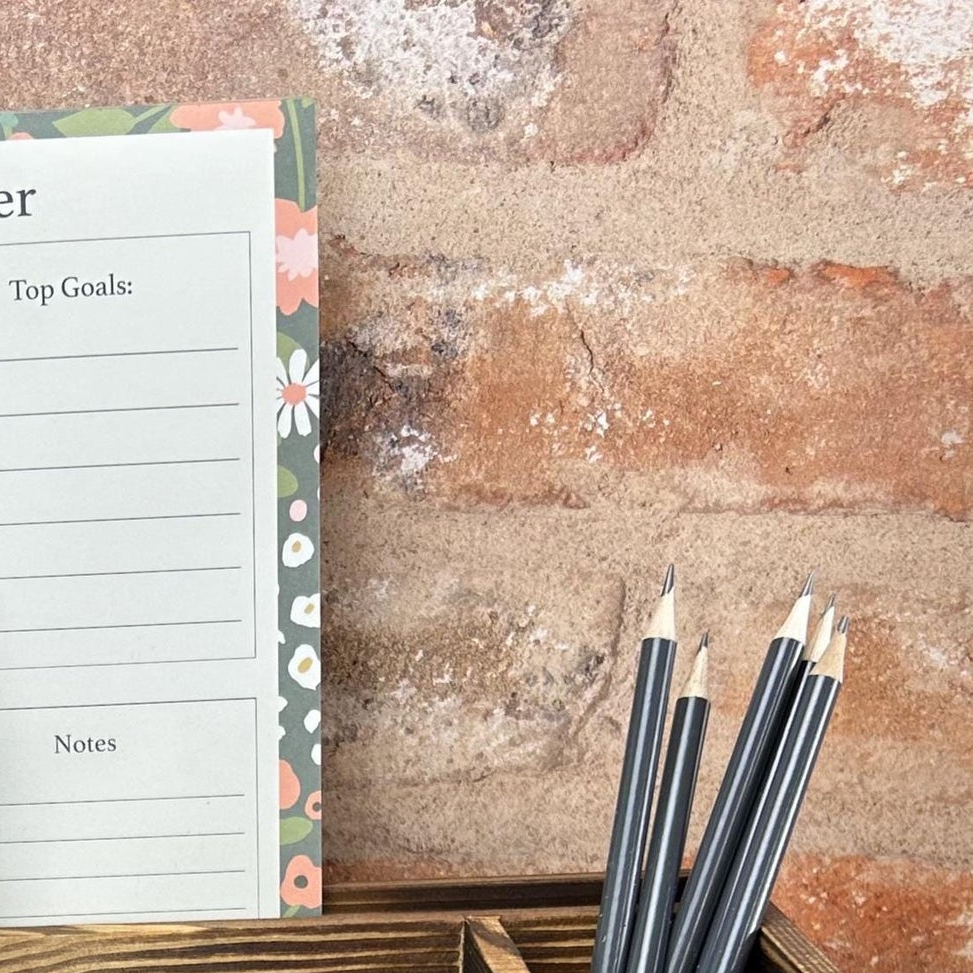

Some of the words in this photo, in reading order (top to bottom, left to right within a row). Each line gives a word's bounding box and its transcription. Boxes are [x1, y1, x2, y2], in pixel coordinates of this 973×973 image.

[8, 279, 54, 306] Top
[60, 273, 133, 299] Goals:
[53, 733, 118, 755] Notes
